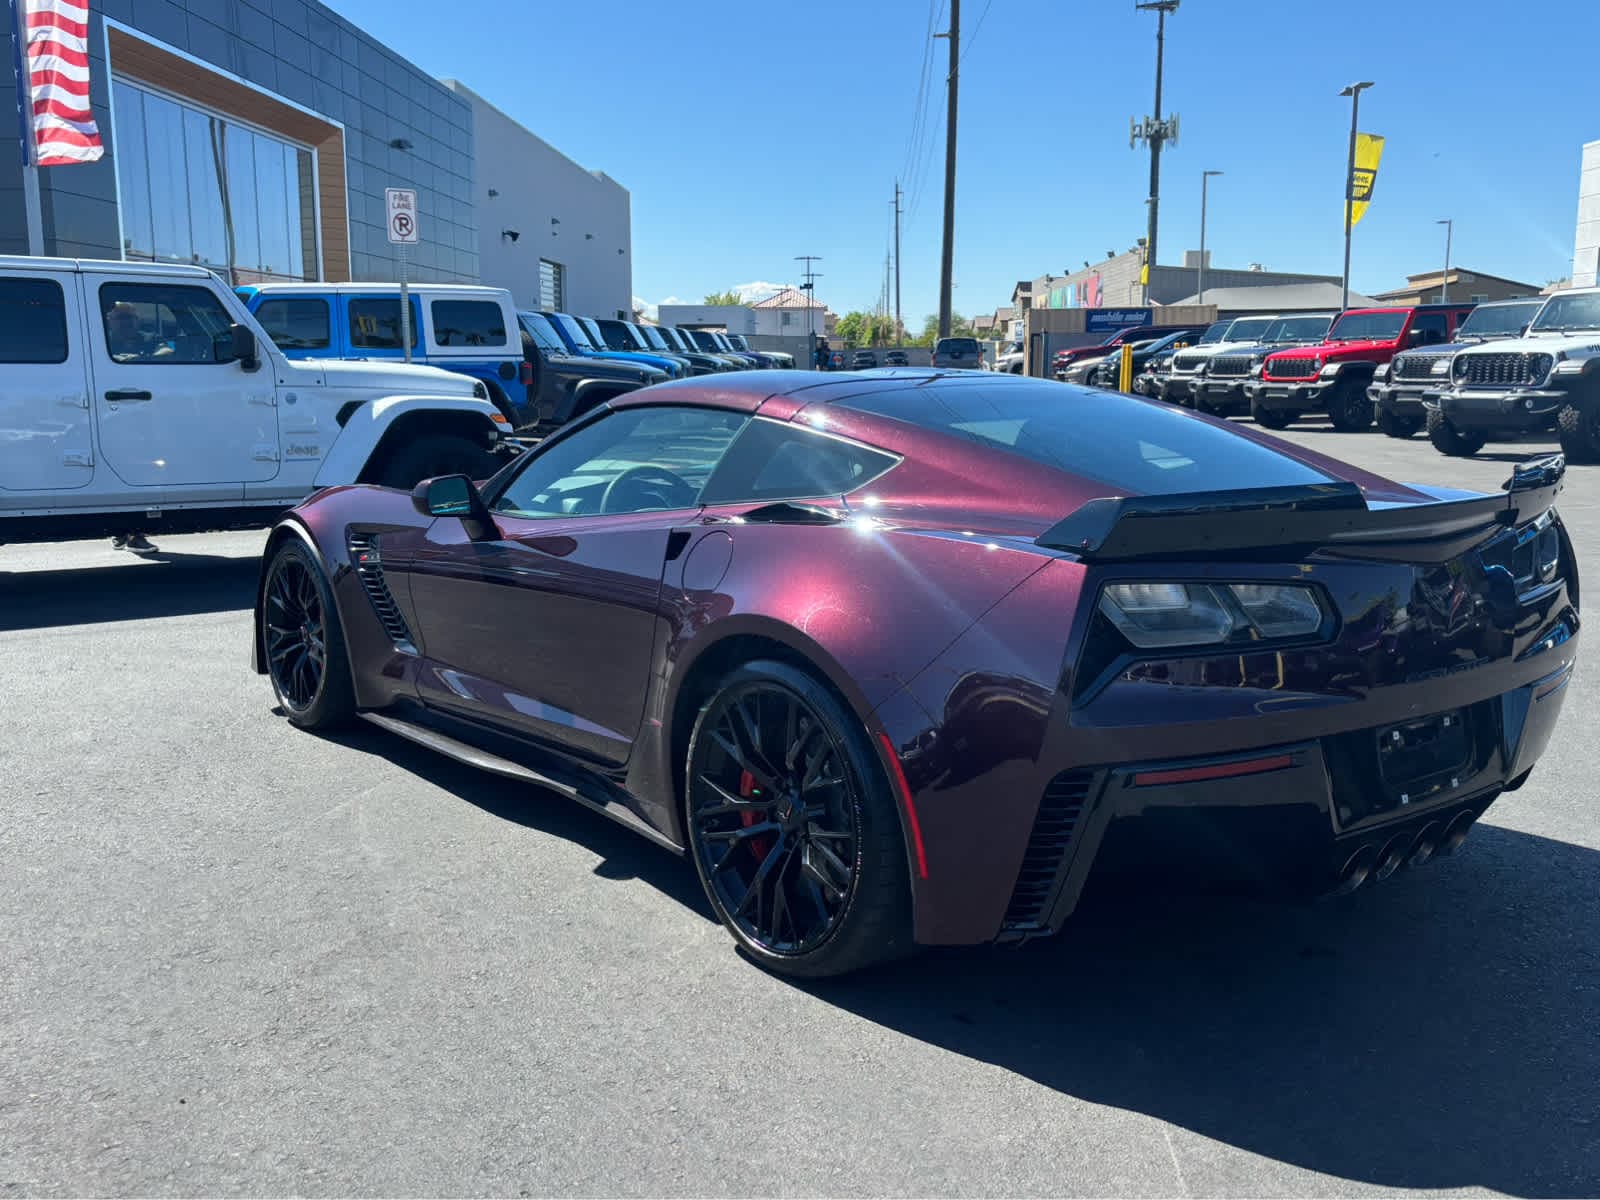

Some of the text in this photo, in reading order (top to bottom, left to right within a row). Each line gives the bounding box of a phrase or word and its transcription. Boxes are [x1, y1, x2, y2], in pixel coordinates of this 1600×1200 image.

[393, 193, 410, 201] FIRE
[391, 202, 412, 210] LANE
[1090, 311, 1125, 322] mobile
[286, 443, 320, 457] Jeep
